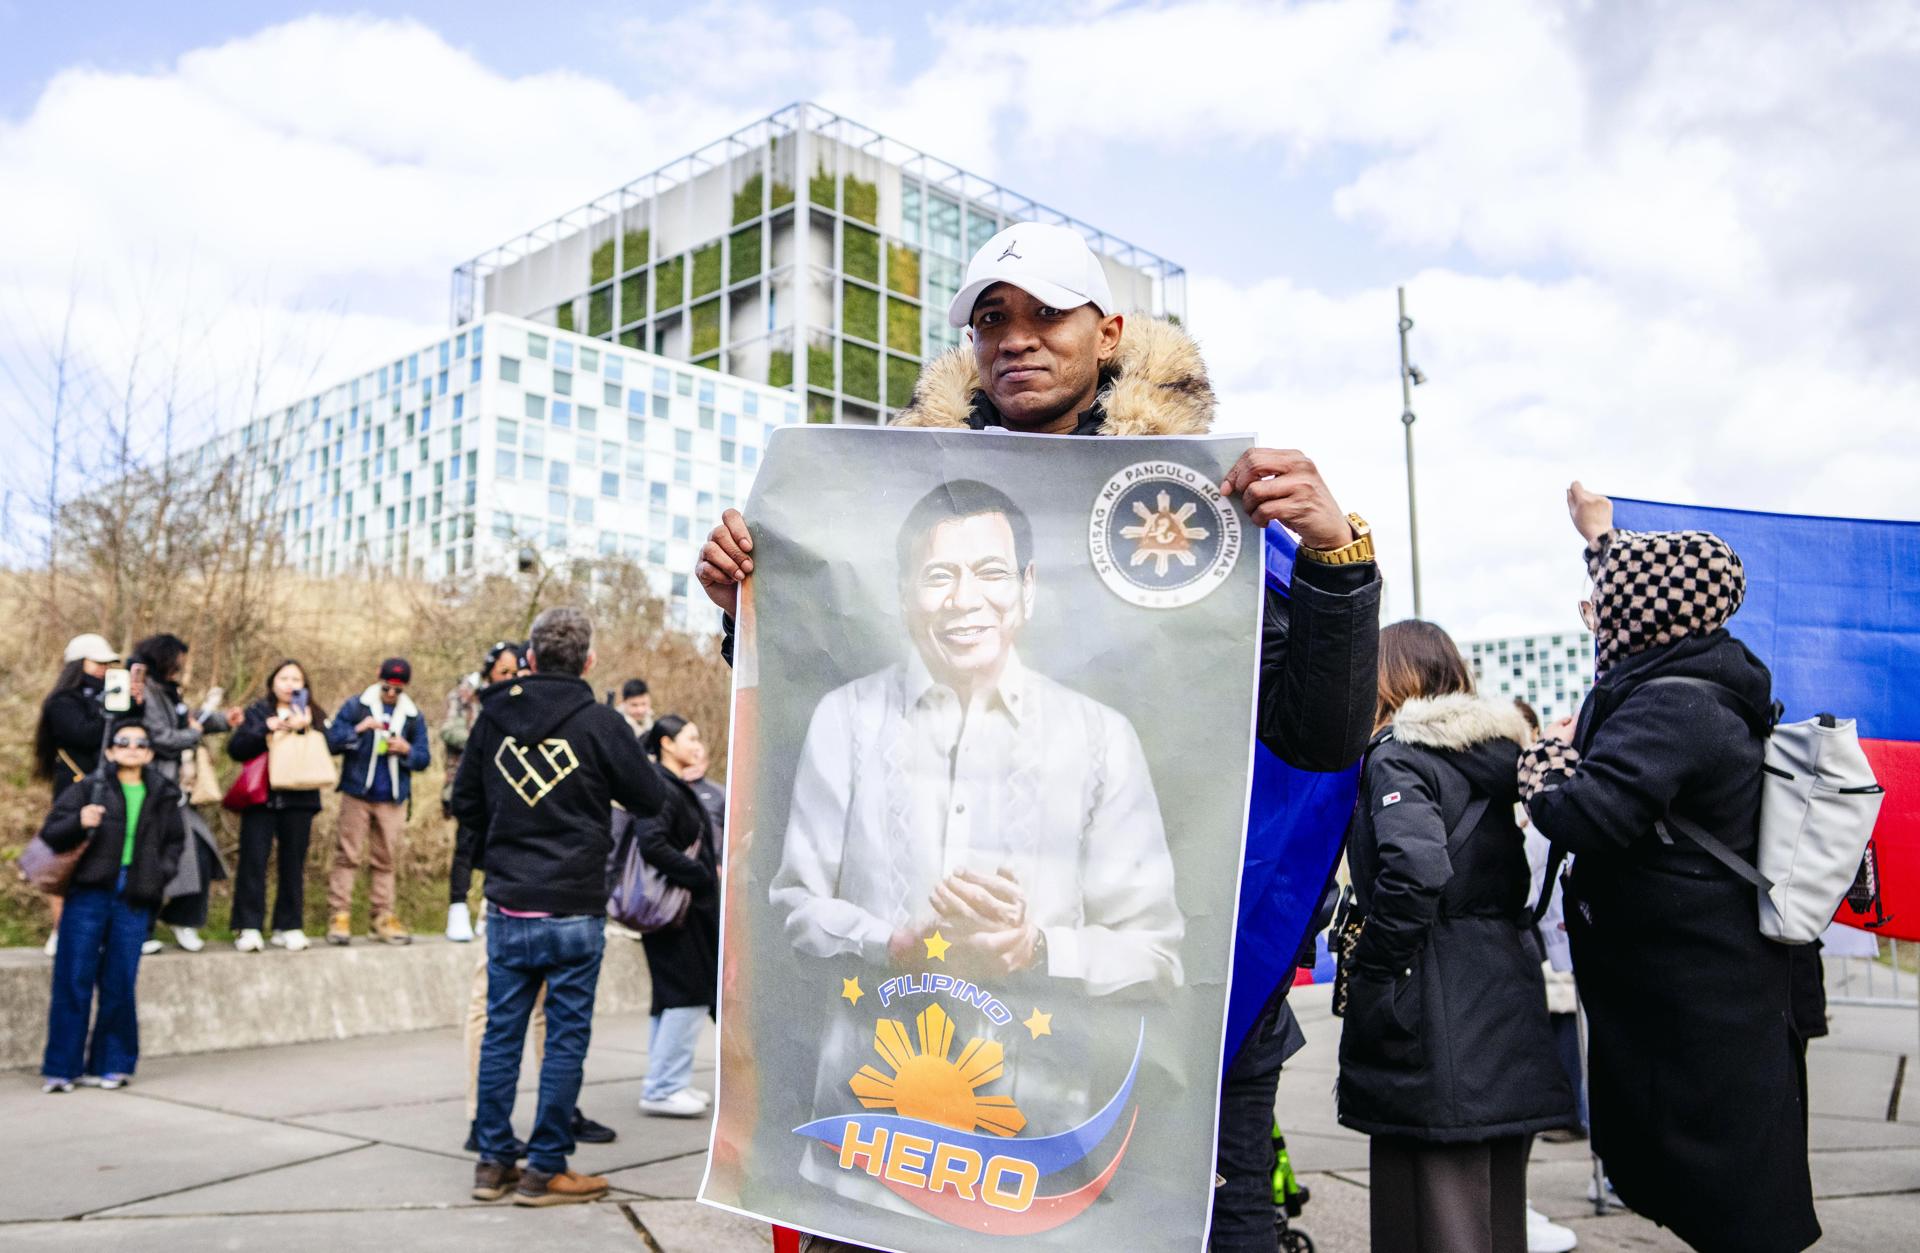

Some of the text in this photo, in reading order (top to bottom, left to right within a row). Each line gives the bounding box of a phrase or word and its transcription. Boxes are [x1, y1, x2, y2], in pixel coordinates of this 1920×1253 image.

[1092, 464, 1239, 578] SAGISAG NG PANGULO NG PILIPINAS
[878, 973, 1012, 1026] FILIPINO
[839, 1121, 1039, 1213] HERO
